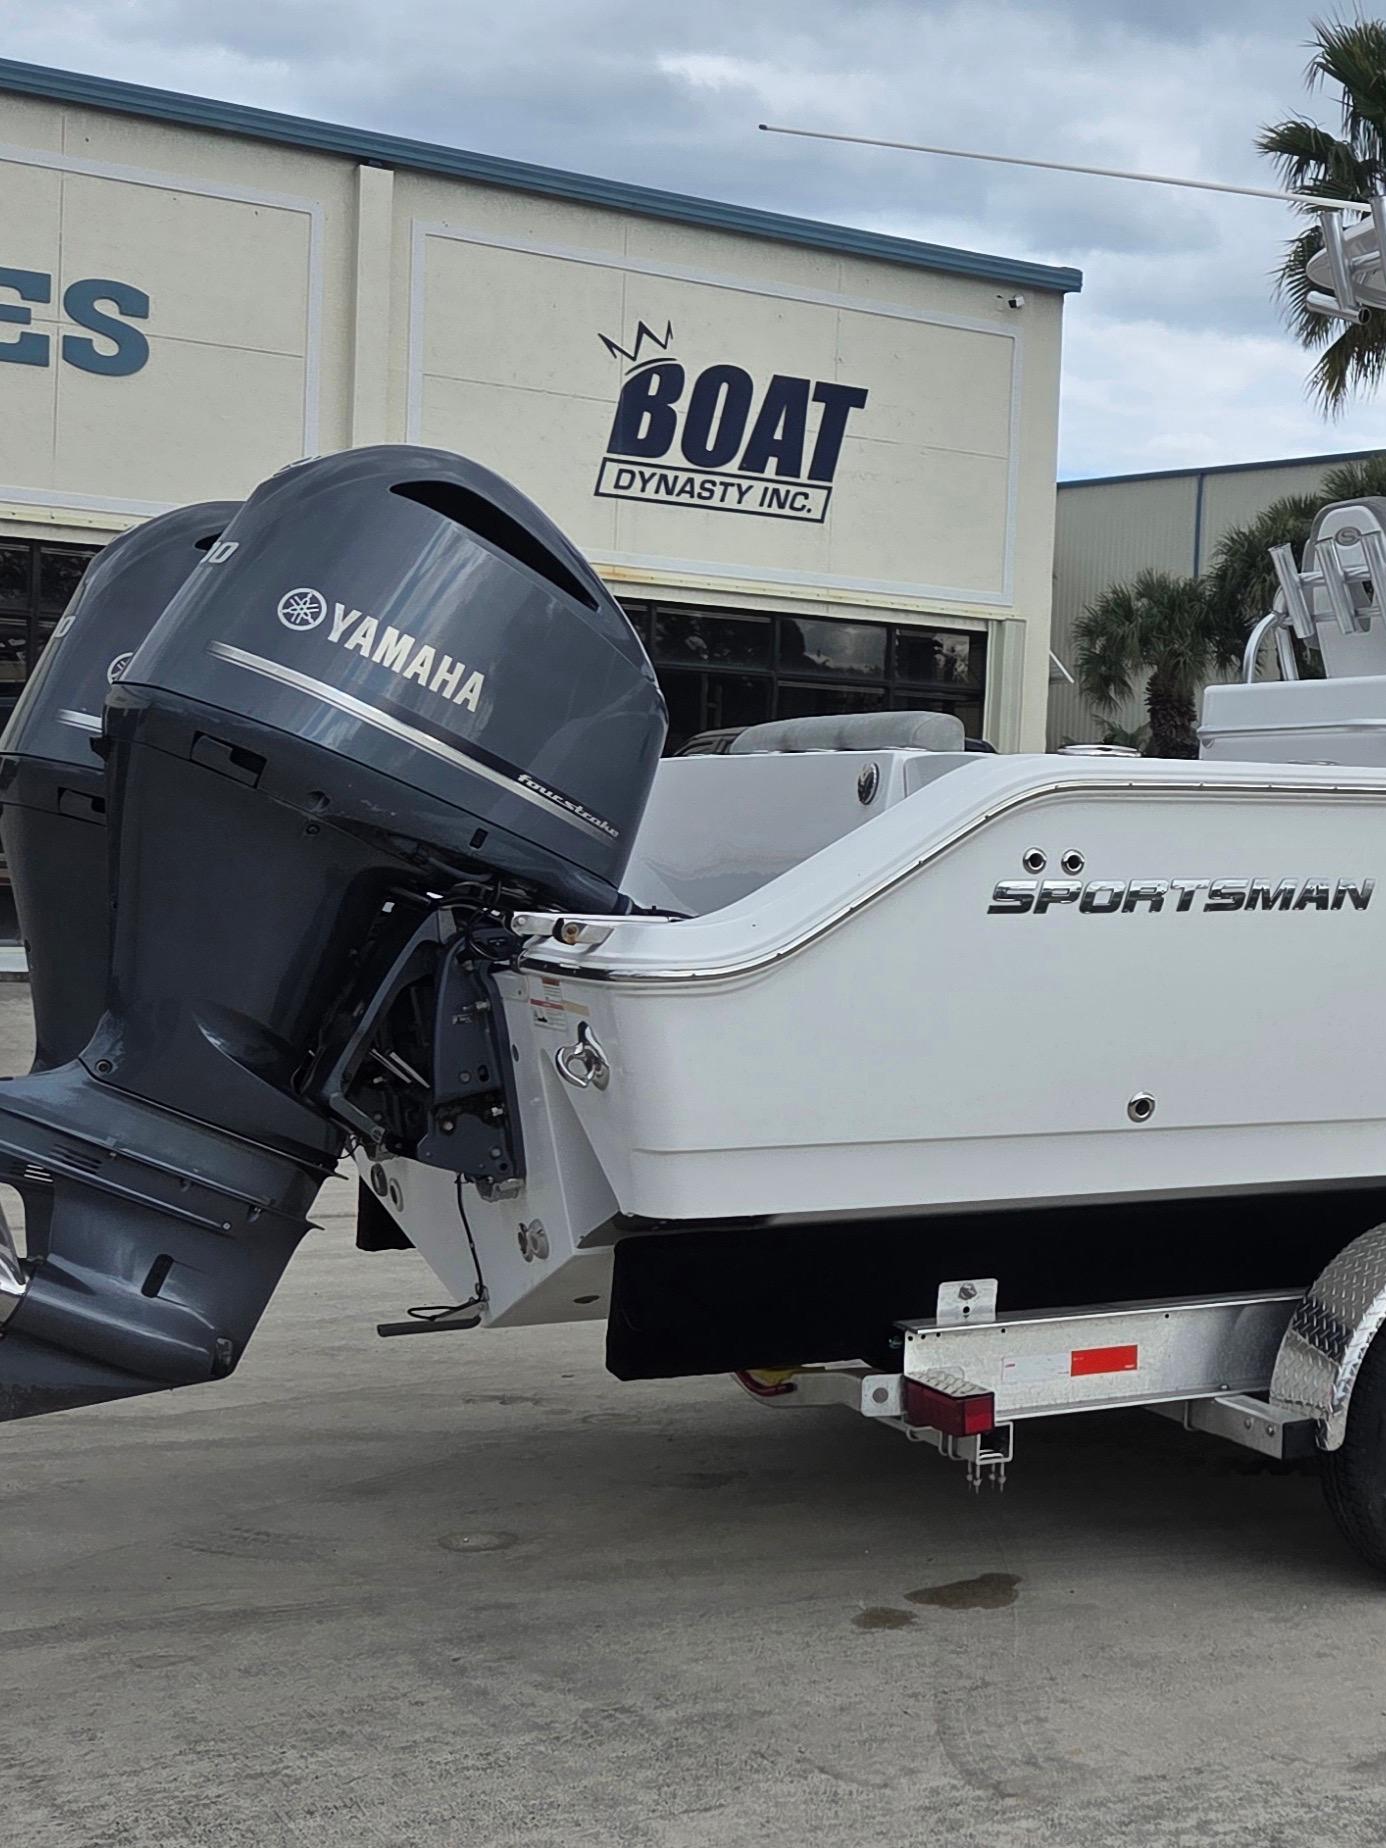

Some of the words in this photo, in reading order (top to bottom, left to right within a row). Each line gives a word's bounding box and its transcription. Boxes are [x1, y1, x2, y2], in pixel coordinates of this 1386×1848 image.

[606, 363, 869, 483] BOAT
[613, 468, 753, 505] DYNASTY
[759, 486, 813, 514] INC.
[327, 602, 485, 713] YAMAHA
[987, 878, 1375, 914] SPORTSMAN
